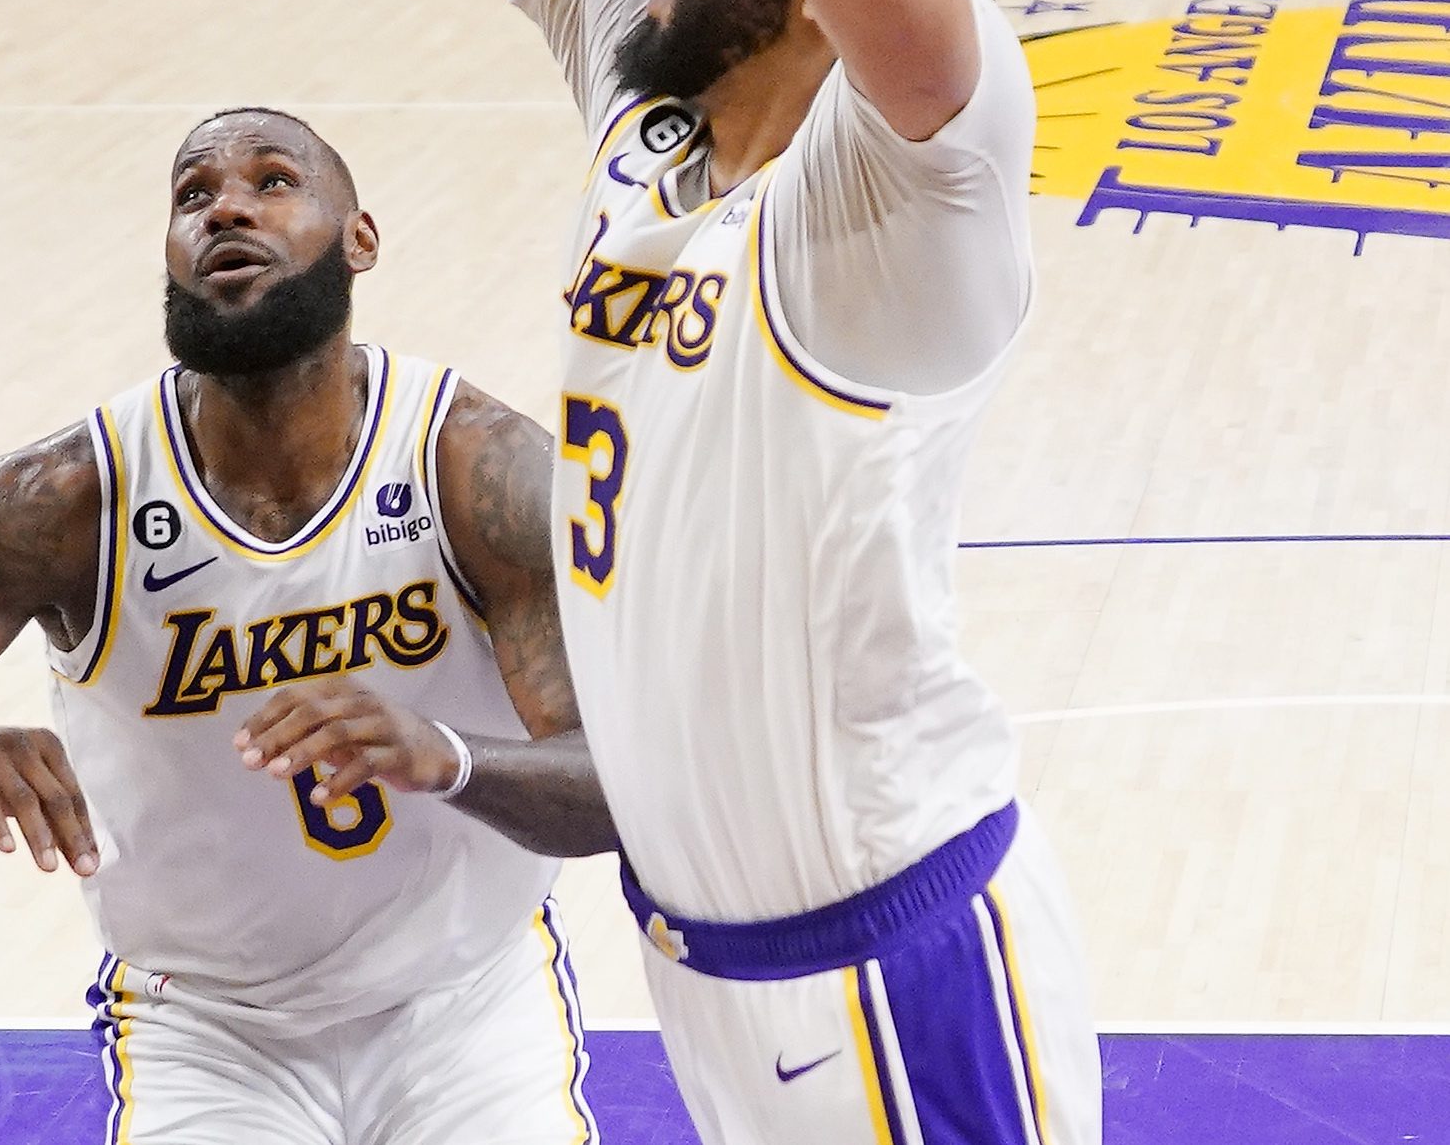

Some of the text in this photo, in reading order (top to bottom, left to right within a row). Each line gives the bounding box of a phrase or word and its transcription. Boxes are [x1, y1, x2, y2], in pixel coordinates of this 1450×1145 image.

[645, 113, 691, 152] 6
[1116, 89, 1241, 156] LOS
[143, 507, 172, 544] 6
[561, 390, 630, 601] 3
[365, 515, 432, 546] bibigo
[141, 577, 450, 719] LAKERS
[288, 758, 394, 863] 6
